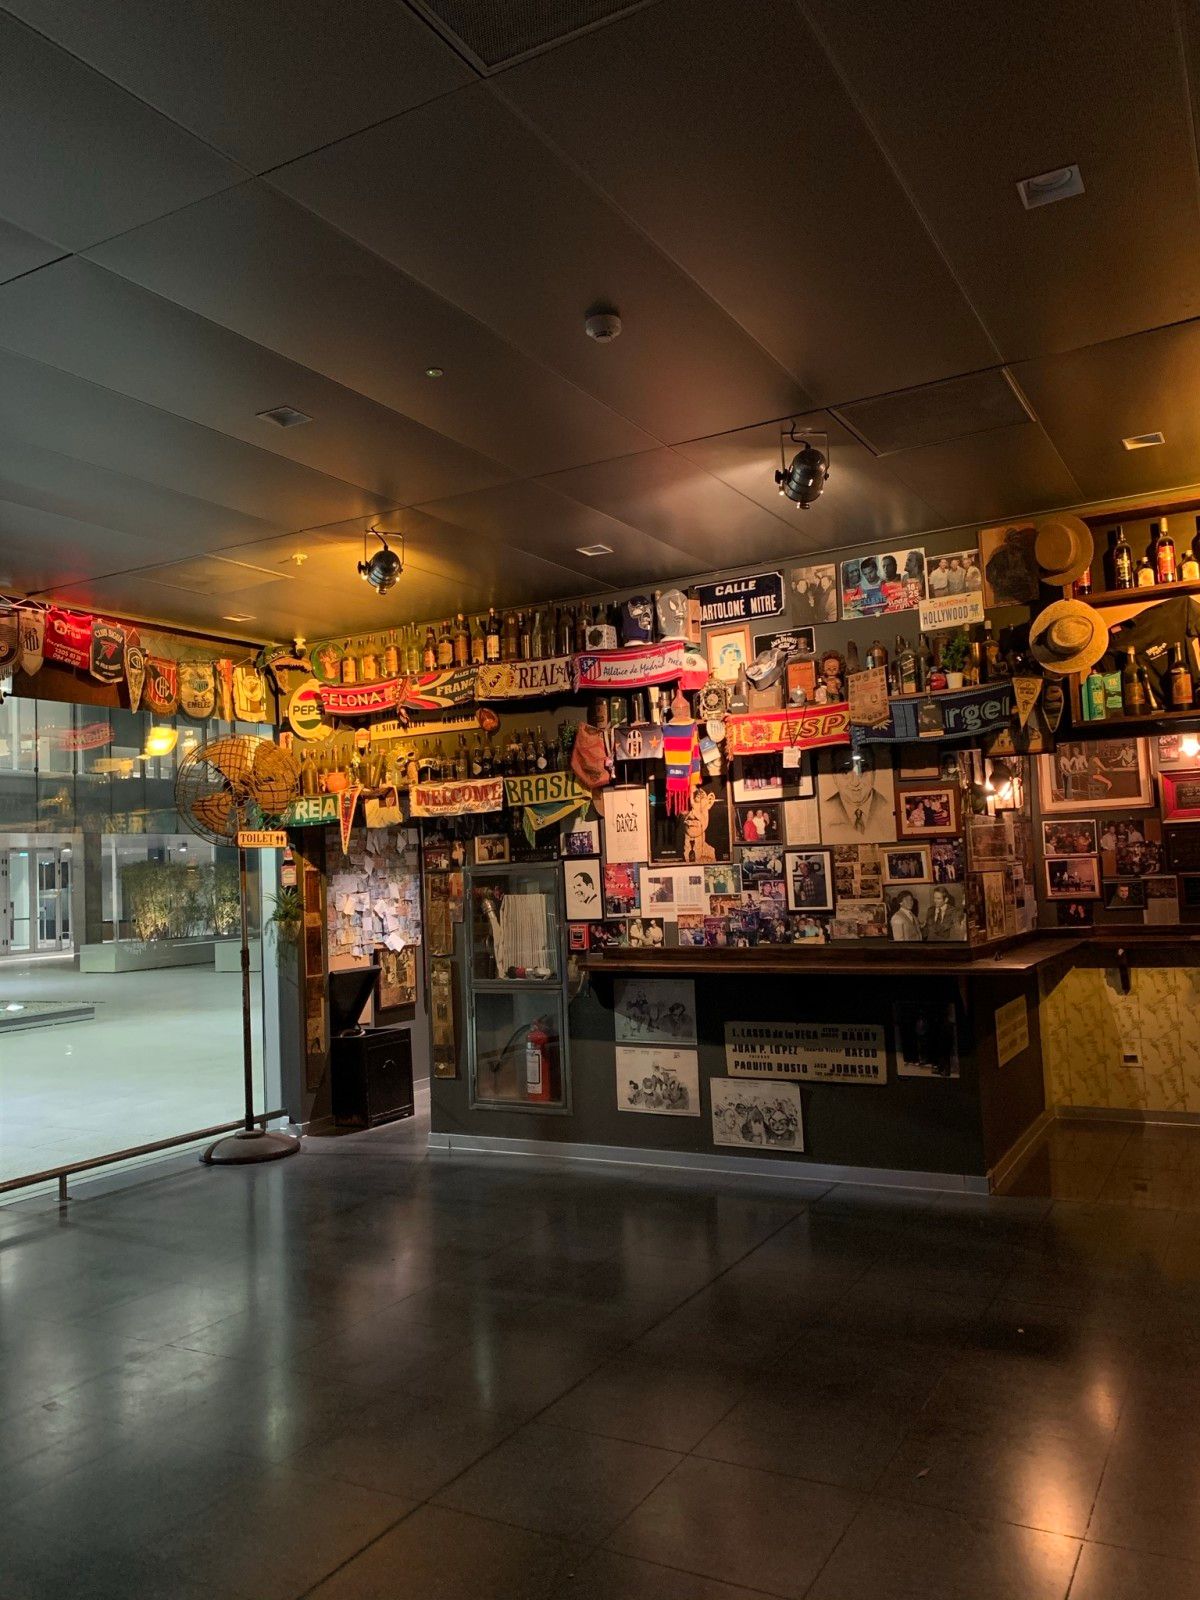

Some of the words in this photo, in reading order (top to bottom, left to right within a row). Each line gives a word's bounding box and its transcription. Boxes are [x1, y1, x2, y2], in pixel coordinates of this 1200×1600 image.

[715, 580, 757, 596] CALLE
[750, 594, 778, 614] MITRE
[923, 605, 969, 625] HOLLYWOOD
[629, 664, 639, 674] de
[519, 664, 558, 690] REAL
[292, 705, 325, 716] PEPS
[416, 781, 502, 806] WELCOME
[505, 772, 583, 803] BRASIL
[616, 818, 638, 833] DANZA
[240, 833, 274, 843] TOILET
[732, 1043, 756, 1053] JUAN
[734, 1060, 773, 1072] PAQUITO
[777, 1062, 808, 1074] BUSTO
[829, 1063, 879, 1075] JOHNSON
